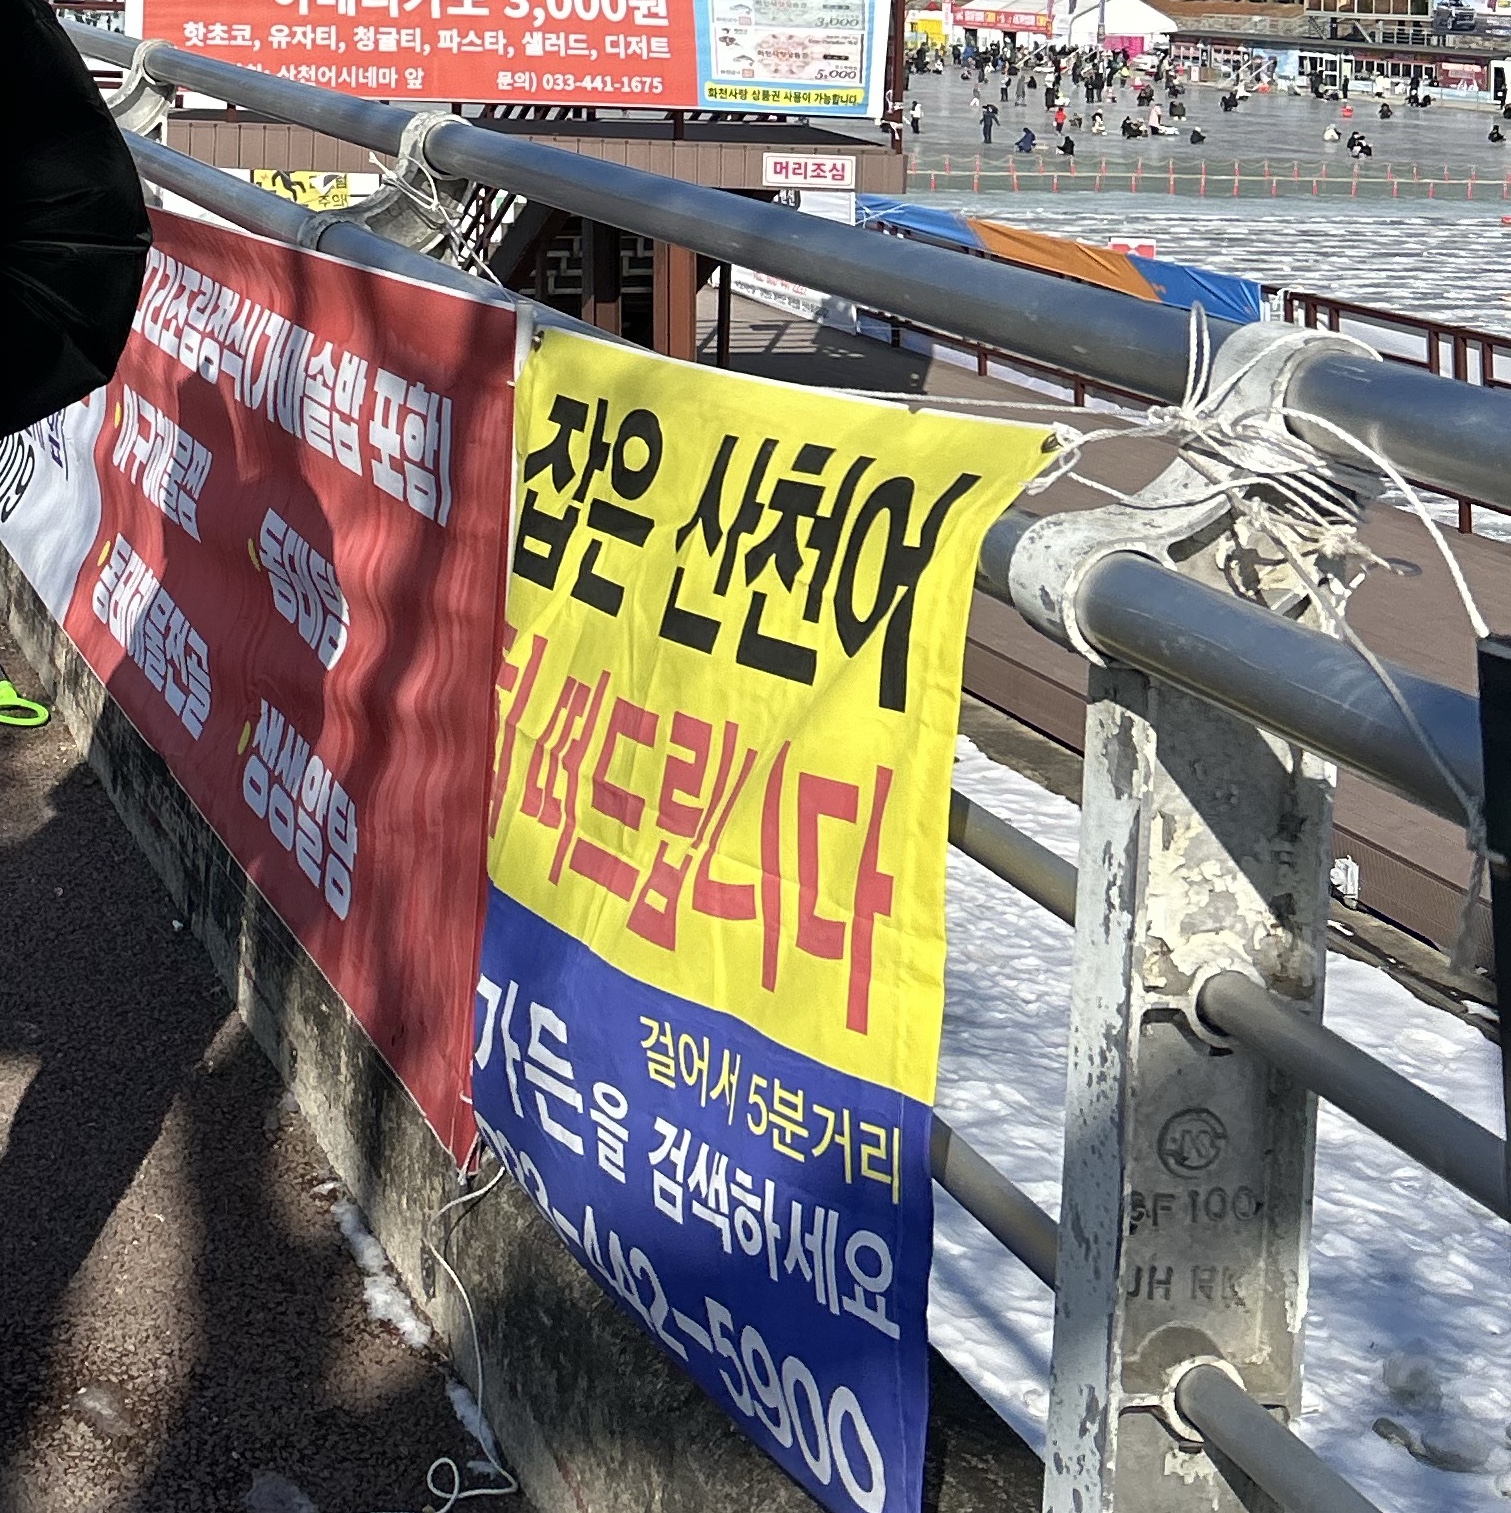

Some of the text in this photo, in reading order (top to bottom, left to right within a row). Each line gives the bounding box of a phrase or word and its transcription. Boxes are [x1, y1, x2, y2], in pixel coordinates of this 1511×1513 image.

[184, 22, 261, 51] 핫초코,
[269, 25, 345, 53] 유자티,
[438, 29, 515, 58] 파스타,
[522, 31, 598, 61] 샐러드,
[605, 34, 671, 60] 디저트
[277, 63, 398, 88] 산천어시네마
[405, 67, 424, 89] 앞
[497, 71, 663, 93] 문의) 033-441-1675
[708, 88, 748, 101] 화천사랑
[751, 90, 781, 102] 상품권
[783, 92, 811, 104] 사용이
[774, 161, 846, 181] 머리조심
[113, 383, 213, 542] 아구해물찜
[131, 246, 454, 527] 다리조림정식(가마솥밥 포함)
[259, 508, 350, 671] 동태탕
[512, 395, 981, 712] 잡은 산천어
[639, 1016, 901, 1205] 걸어서 5분거리
[648, 1116, 901, 1339] 검색하세요
